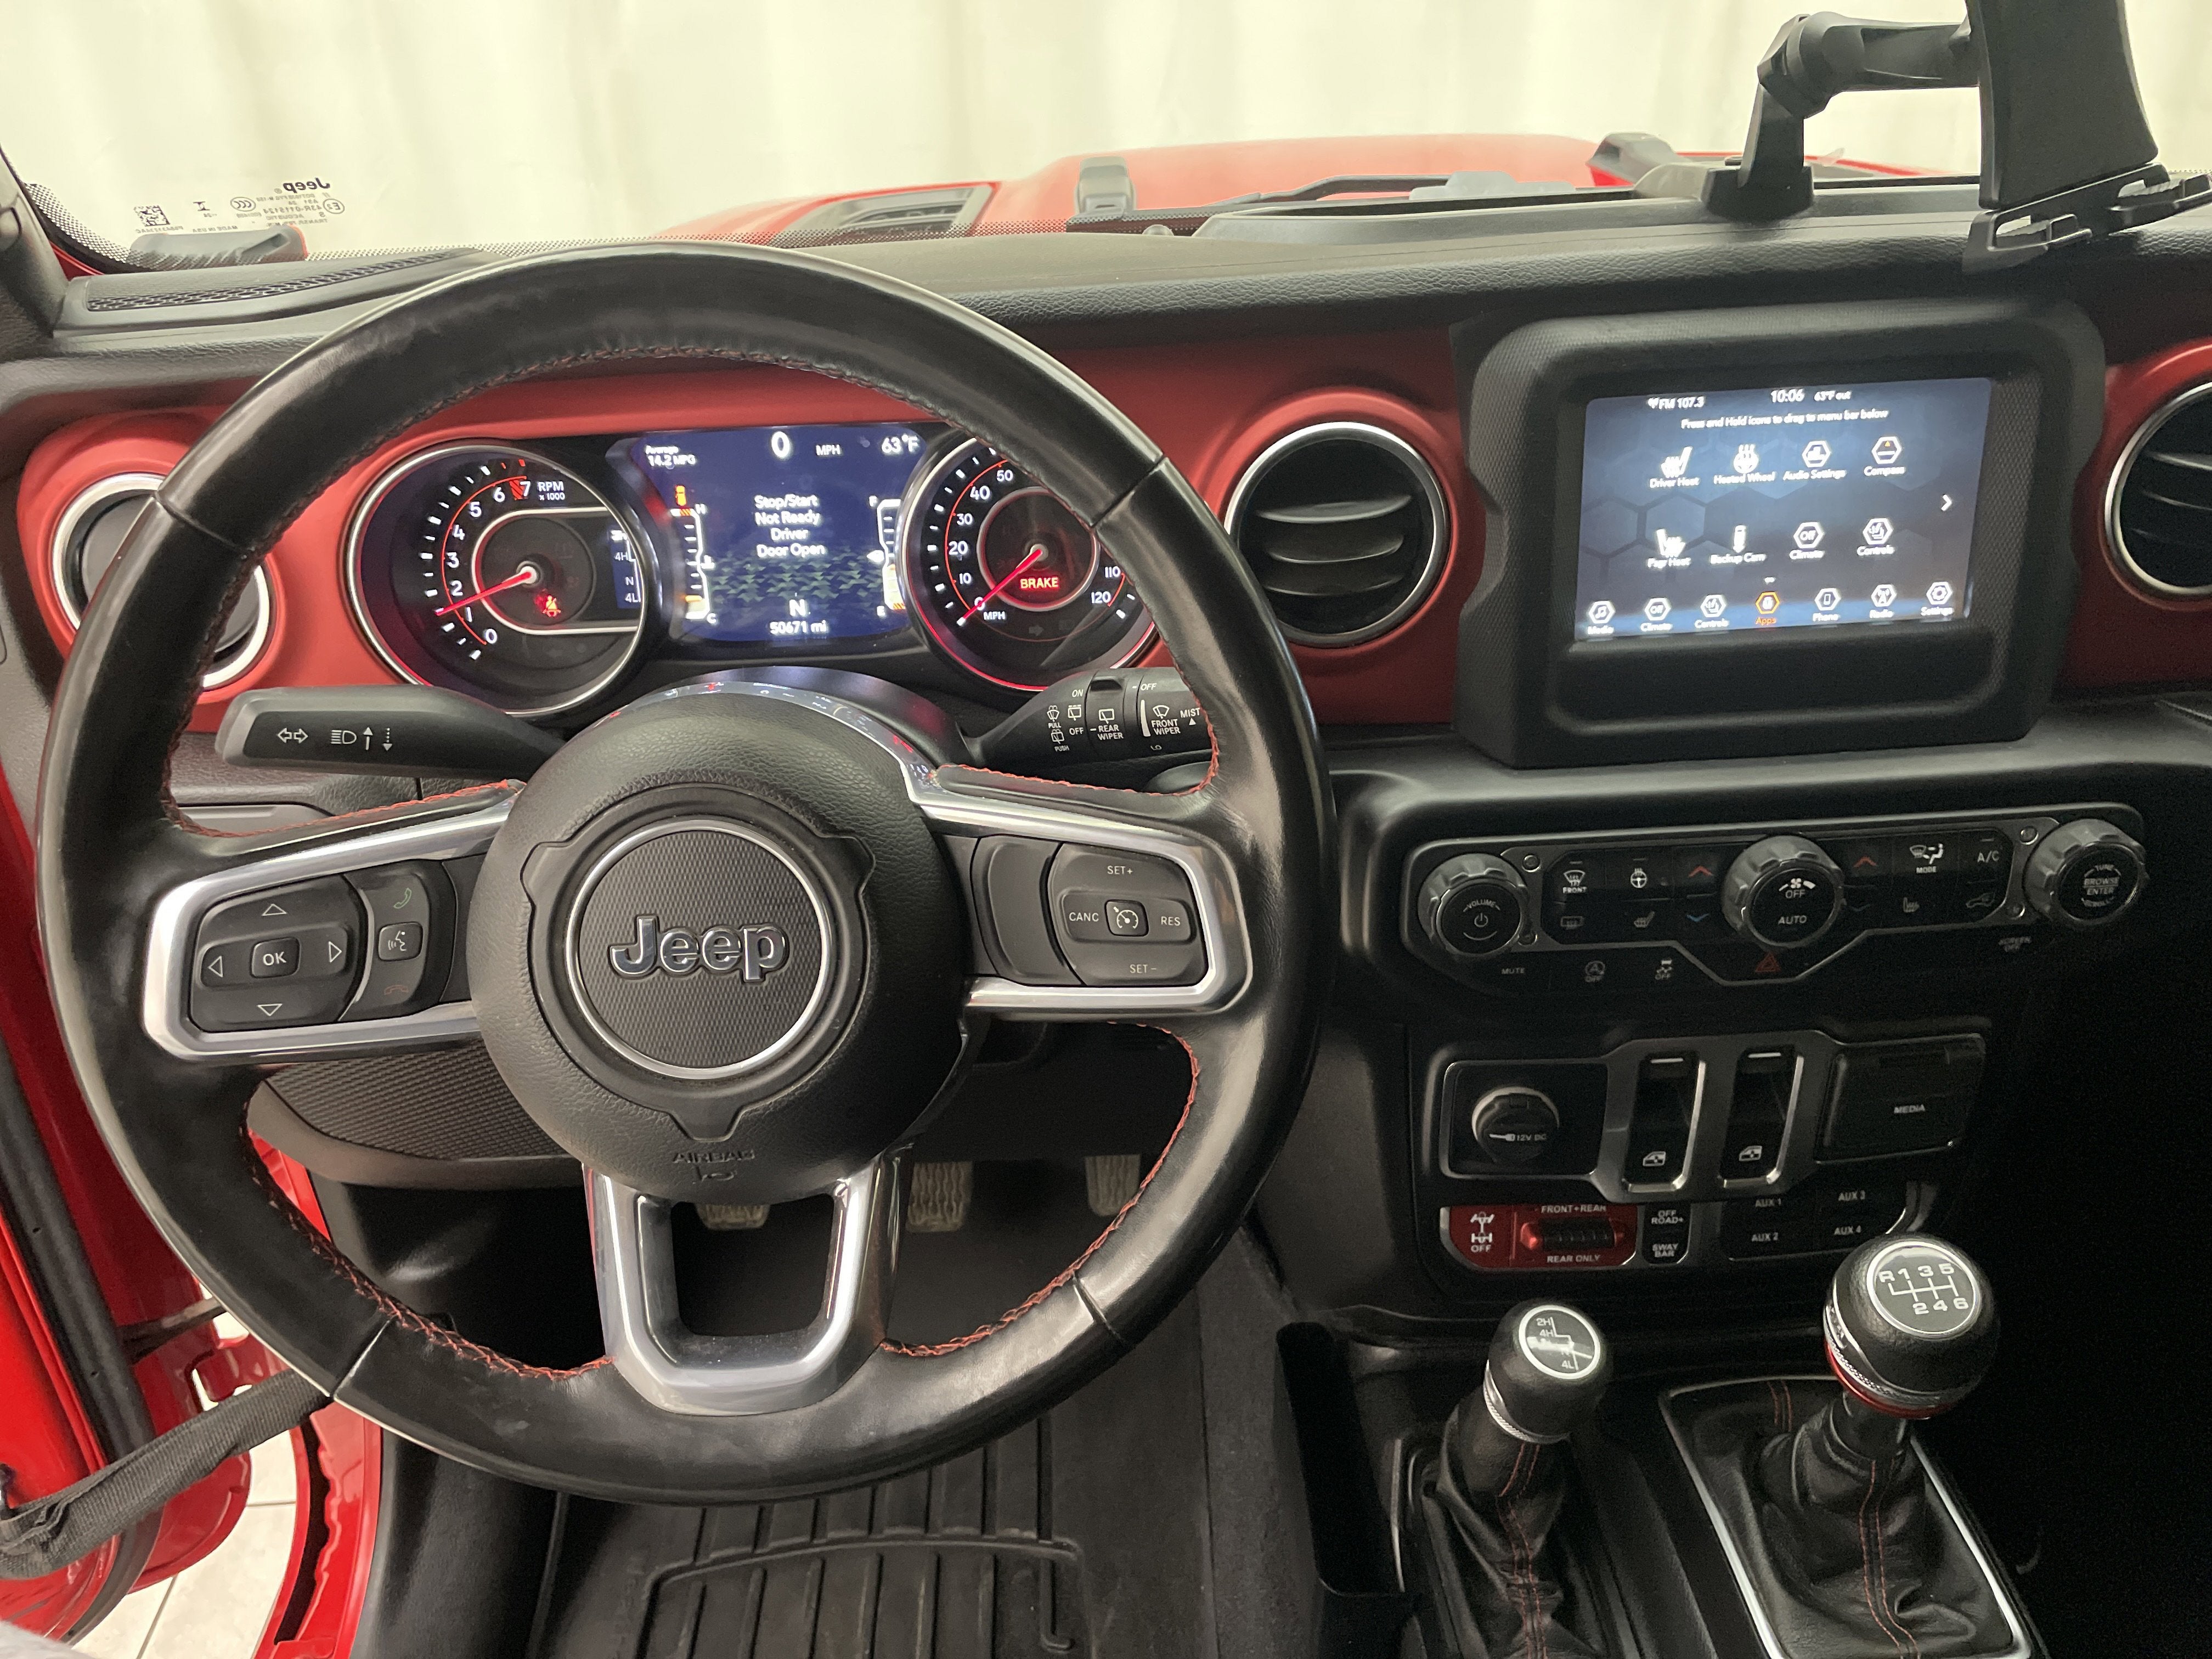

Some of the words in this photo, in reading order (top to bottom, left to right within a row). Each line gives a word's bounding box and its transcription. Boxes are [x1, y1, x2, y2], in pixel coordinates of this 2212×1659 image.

[1771, 388, 1805, 403] 10:06
[1836, 391, 1851, 400] out
[1658, 398, 1675, 409] FM
[1677, 396, 1705, 409] 107.3
[1706, 417, 1724, 428] and
[1725, 415, 1747, 427] Hold
[1772, 415, 1782, 425] to
[1806, 413, 1816, 422] to
[1817, 412, 1842, 422] menu
[1843, 410, 1860, 421] bar
[1860, 409, 1889, 419] below
[771, 431, 791, 459] 0
[882, 434, 919, 454] 63°F
[816, 444, 841, 456] MPH
[648, 455, 672, 466] 14.2
[673, 454, 696, 465] MPG
[996, 470, 1014, 482] 50
[1783, 470, 1809, 481] Audio
[1810, 468, 1847, 480] Settings
[1864, 465, 1905, 477] Compass
[1650, 477, 1676, 488] Driver
[1678, 476, 1700, 487] Heat
[1747, 472, 1775, 483] Wheel
[520, 481, 531, 496] 7
[537, 481, 565, 492] RPM
[494, 487, 505, 503] 6
[546, 493, 566, 501] 1000
[970, 485, 990, 500] 40
[754, 494, 819, 510] Stop/Start
[469, 501, 482, 518] 5
[695, 504, 707, 515] H
[755, 512, 779, 525] Not
[781, 510, 822, 527] Ready
[956, 513, 973, 526] 30
[453, 524, 465, 540] 4
[771, 527, 809, 541] Driver
[757, 545, 788, 558] Door
[790, 544, 826, 559] Open
[949, 541, 968, 556] 20
[1857, 545, 1895, 556] Controls
[447, 551, 460, 568] 3
[614, 552, 628, 561] 4H
[1789, 549, 1824, 560] Climate
[1104, 566, 1121, 578] 110
[625, 577, 634, 585] N
[959, 572, 972, 584] 10
[1020, 577, 1059, 589] BRAKE
[450, 581, 463, 596] 2
[625, 592, 639, 603] 4L
[1091, 592, 1111, 604] 120
[789, 600, 808, 616] N
[1869, 609, 1893, 618] Radio
[465, 607, 472, 623] 1
[706, 613, 717, 624] C
[983, 611, 1006, 620] MPH
[1813, 612, 1839, 622] Phone
[770, 620, 808, 634] 50671
[810, 619, 827, 633] mi
[1756, 617, 1776, 625] Apps
[484, 628, 498, 644] 0
[1140, 683, 1157, 691] OFF
[1071, 689, 1084, 698] ON
[1180, 708, 1200, 718] MIST
[1098, 724, 1119, 732] REAR
[1151, 719, 1178, 728] FRONT
[1069, 727, 1084, 736] OFF
[1097, 732, 1124, 741] WIPER
[1153, 726, 1181, 736] WIPER
[1054, 744, 1070, 753] PUSH
[1977, 850, 2000, 864] A/C
[1916, 865, 1937, 874] MODE
[2084, 876, 2120, 885] BROWSE
[1562, 886, 1587, 894] FRONT
[1785, 889, 1806, 899] OFF
[2086, 887, 2114, 896] ENTER
[1466, 899, 1497, 909] VOLUME
[1069, 912, 1099, 922] CANC
[1161, 916, 1181, 927] RES
[1778, 915, 1807, 925] AUTO
[609, 914, 791, 983] Jeep
[263, 951, 287, 966] OK
[1894, 1104, 1926, 1114] MEDIA
[672, 1149, 755, 1164] AIRBAG
[1838, 1192, 1858, 1201] AUX
[1755, 1199, 1774, 1207] AUX
[1657, 1209, 1677, 1217] OFF
[1833, 1226, 1854, 1235] AUX
[1751, 1233, 1771, 1242] AUX
[1471, 1244, 1491, 1253] OFF
[1652, 1243, 1679, 1251] SWAY
[1547, 1255, 1573, 1263] REAR
[1575, 1254, 1601, 1263] ONLY
[1654, 1250, 1675, 1258] BAR
[1878, 1270, 1895, 1283] R
[1898, 1267, 1911, 1280] 1
[1917, 1265, 1934, 1278] 3
[1938, 1263, 1955, 1275] 5
[1912, 1302, 1930, 1316] 2
[1932, 1300, 1949, 1312] 4
[1953, 1297, 1969, 1310] 6
[1536, 1318, 1551, 1327] 2H
[1539, 1329, 1554, 1338] 4H
[1561, 1360, 1575, 1369] 4L
